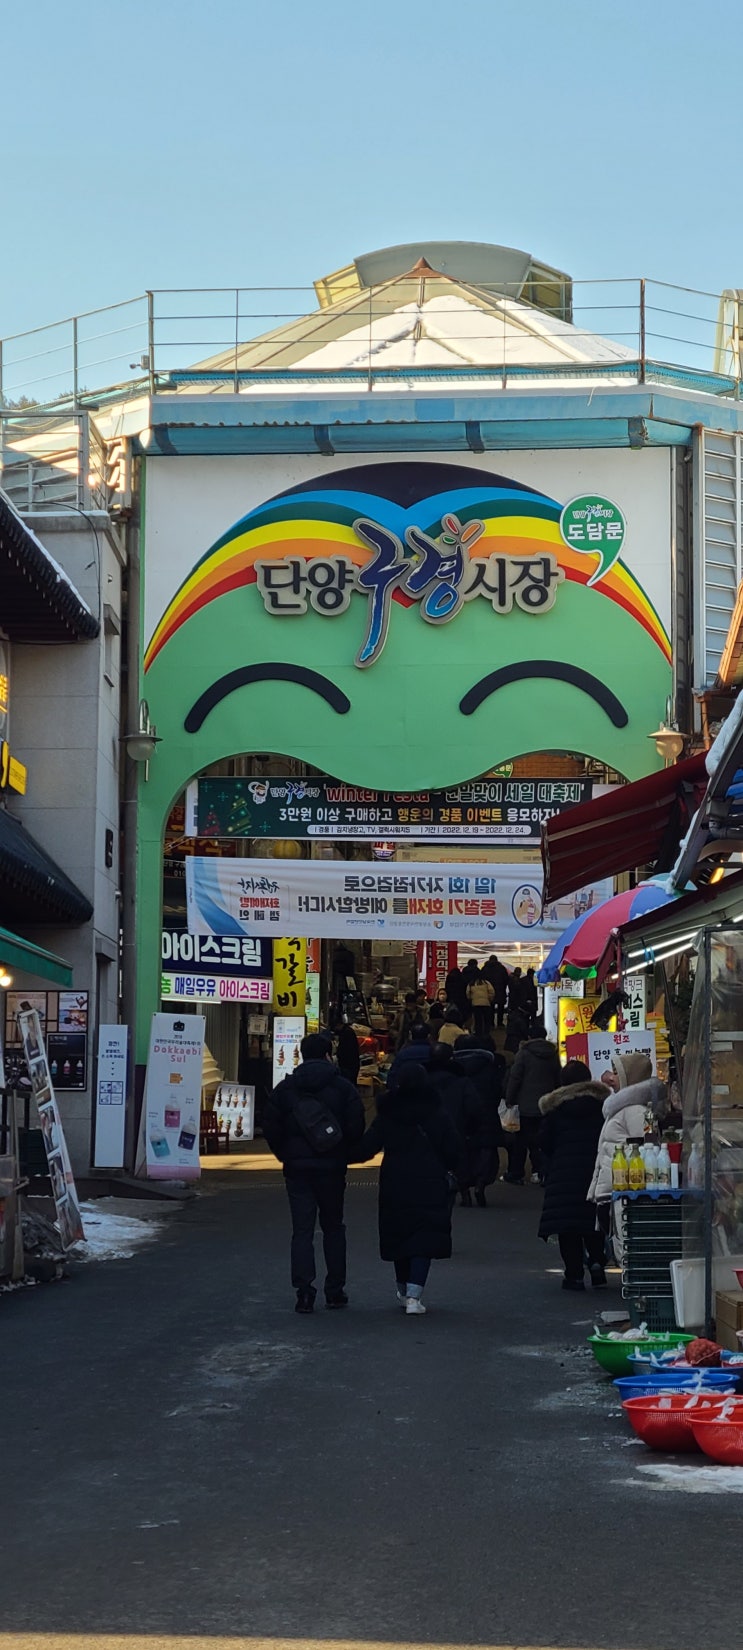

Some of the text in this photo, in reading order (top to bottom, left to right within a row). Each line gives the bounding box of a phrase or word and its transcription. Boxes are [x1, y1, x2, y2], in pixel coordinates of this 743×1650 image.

[567, 522, 623, 540] 도담문
[505, 783, 535, 802] 세일
[279, 807, 312, 822] 3만원
[316, 807, 340, 822] 이상
[345, 807, 393, 822] 구매하고
[397, 808, 434, 822] 행운의
[439, 808, 462, 822] 경품
[467, 808, 503, 822] 이벤트
[161, 932, 262, 967] 아이스크림
[175, 977, 216, 997] 매일우유
[219, 979, 270, 1001] 아이스크림
[613, 1034, 630, 1045] 원조
[170, 1054, 186, 1063] Sul
[594, 1049, 611, 1061] 단양
